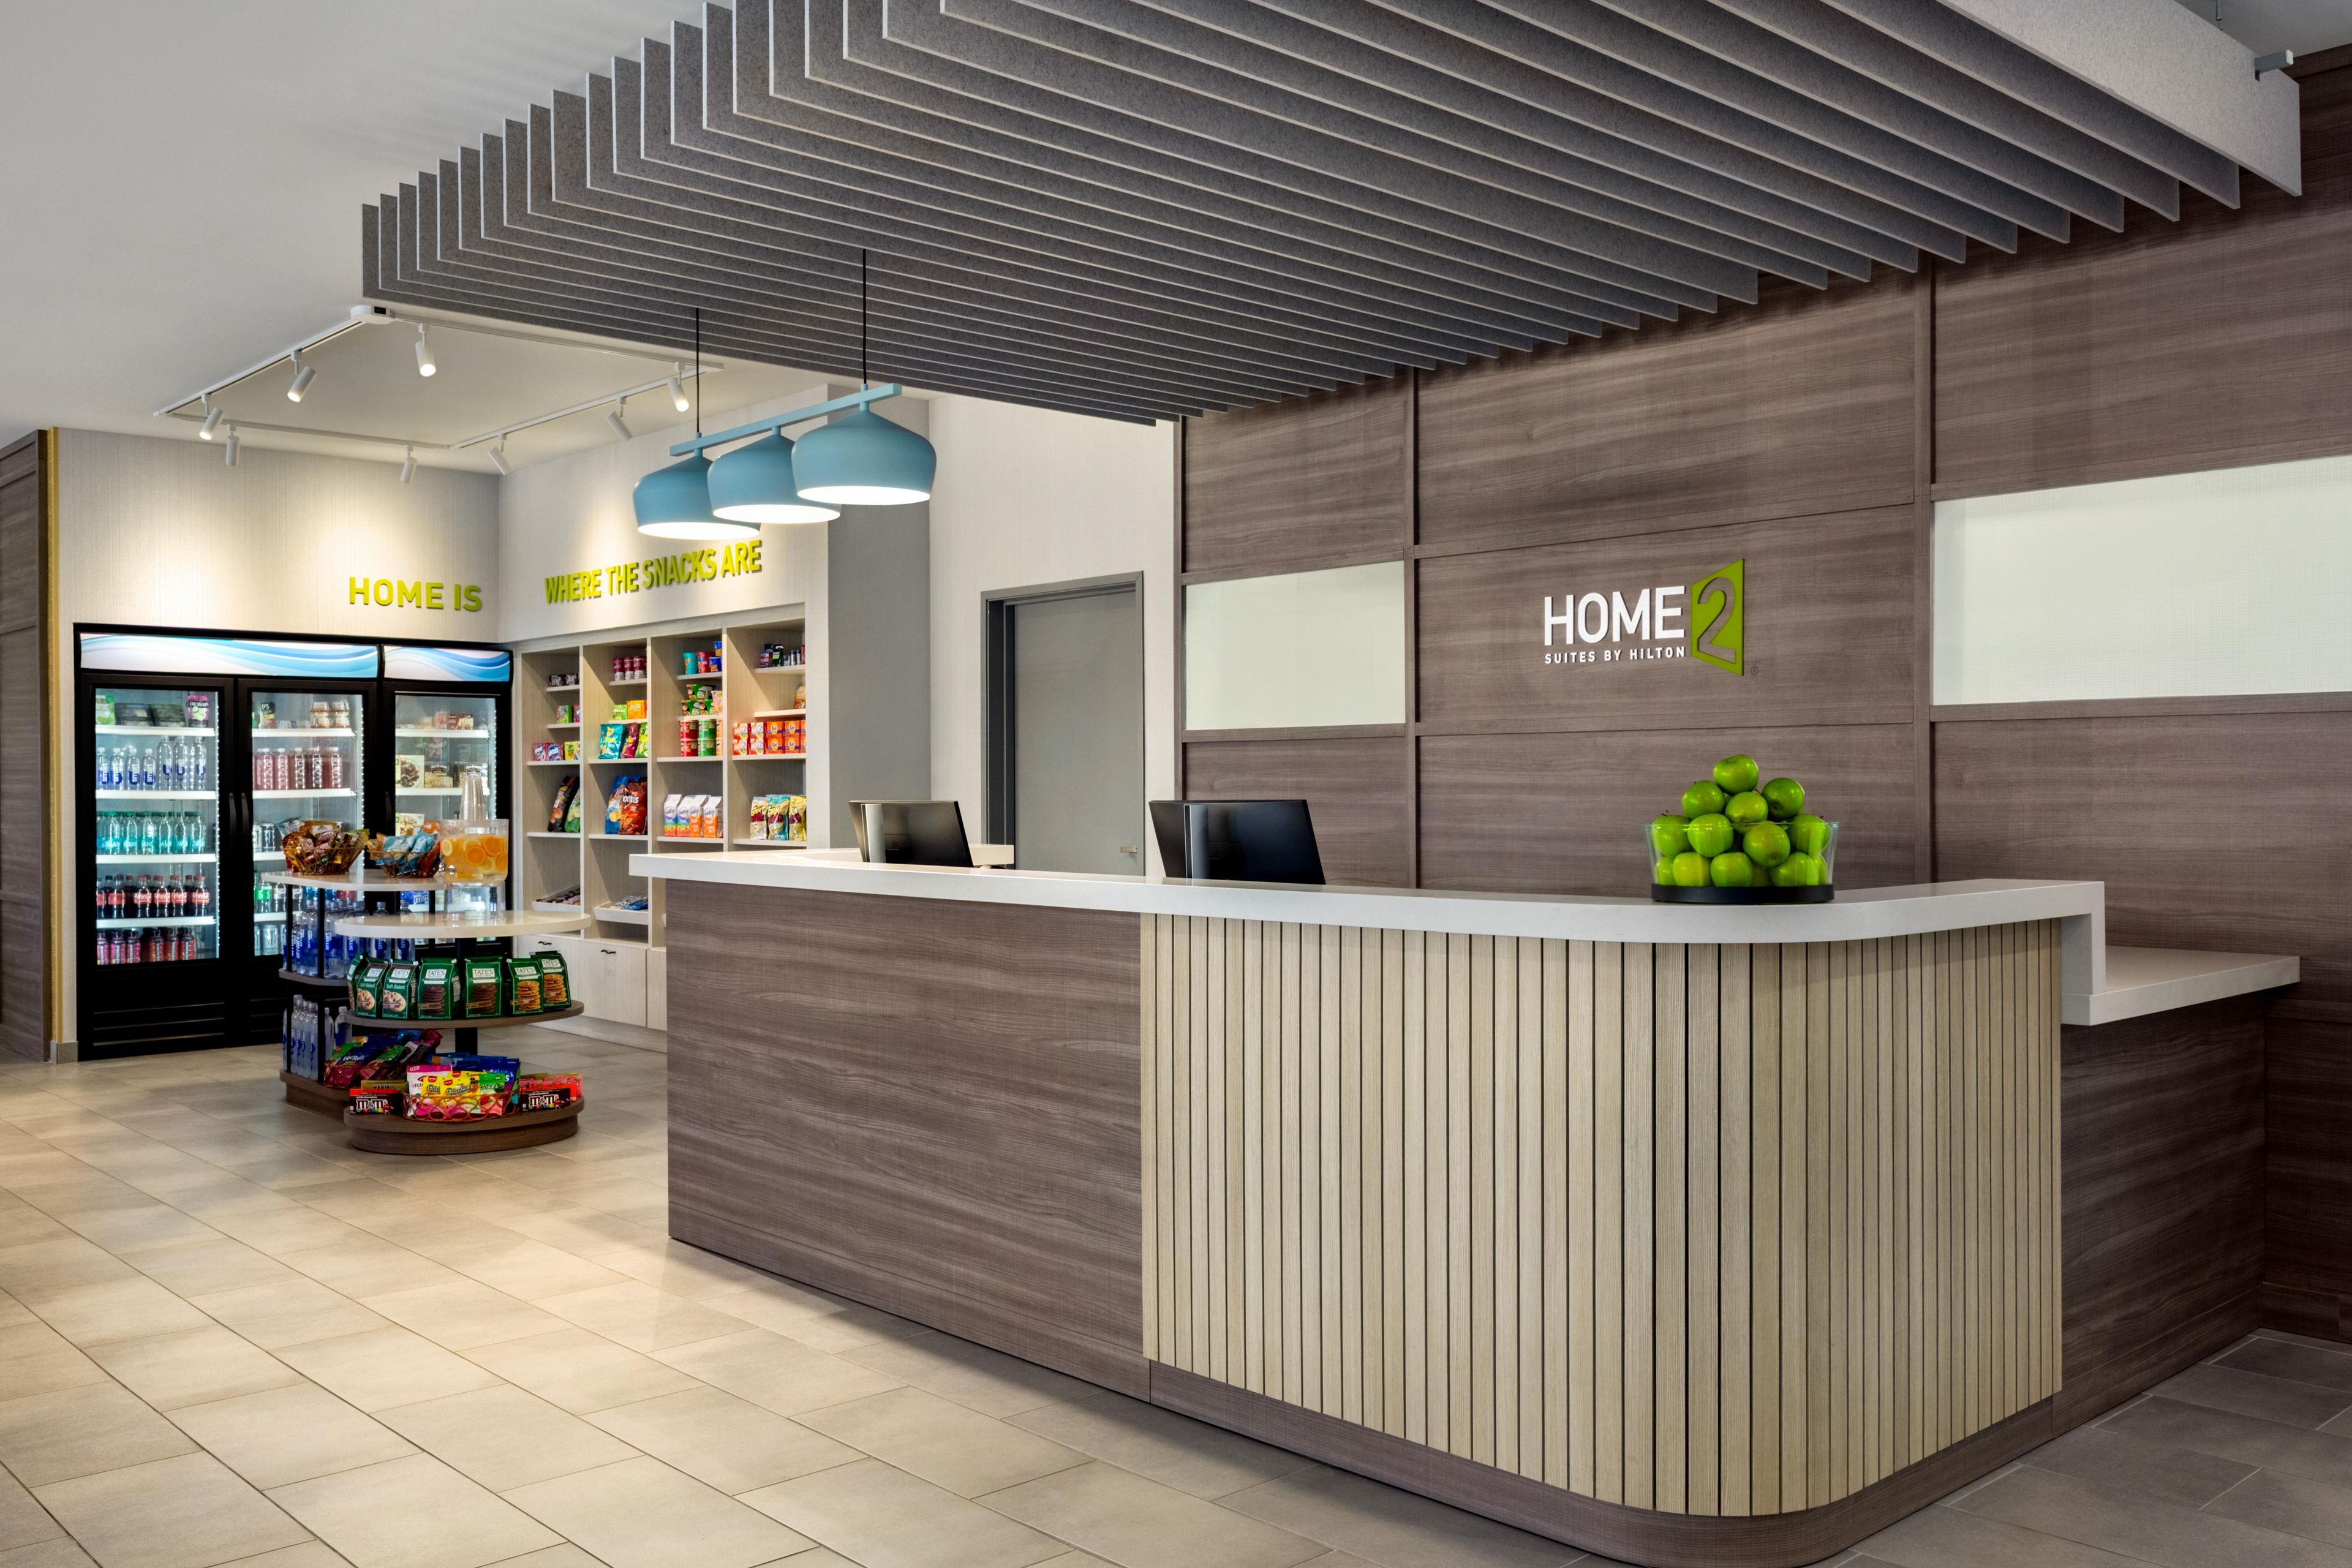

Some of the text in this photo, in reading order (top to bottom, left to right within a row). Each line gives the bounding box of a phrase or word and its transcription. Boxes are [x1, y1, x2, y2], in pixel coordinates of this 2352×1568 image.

[349, 576, 483, 612] HOME IS
[545, 539, 762, 604] WHERE THE SNACKS ARE
[1544, 586, 1686, 646] HOME
[1544, 646, 1686, 665] SUITES BY HILTON
